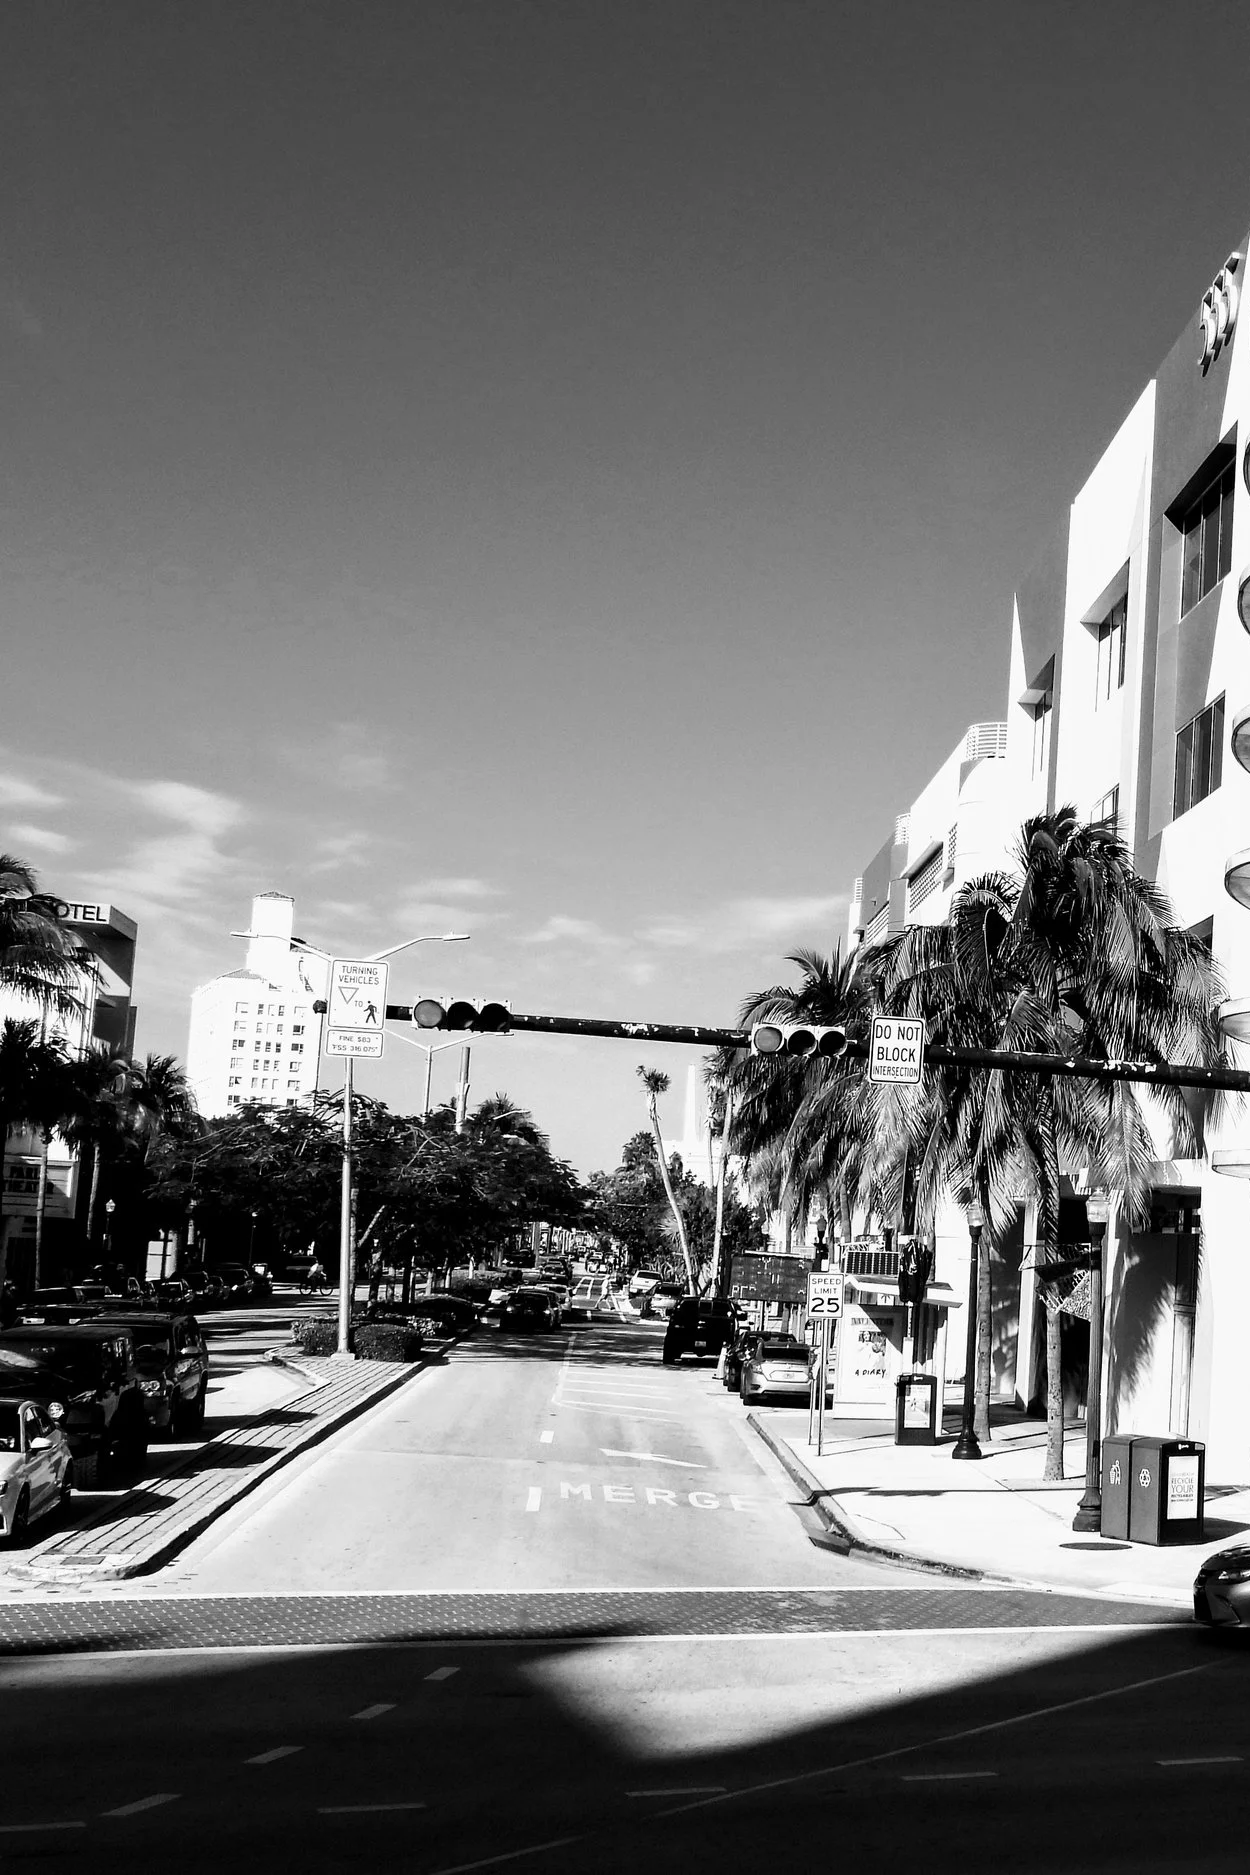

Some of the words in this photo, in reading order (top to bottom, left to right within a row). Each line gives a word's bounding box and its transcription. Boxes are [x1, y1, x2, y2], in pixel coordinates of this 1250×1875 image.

[56, 902, 107, 922] OTEL
[342, 965, 378, 976] TURNING
[339, 974, 380, 986] VEHICLES
[354, 1000, 364, 1008] TO
[875, 1024, 892, 1039] DO
[897, 1026, 921, 1041] NOT
[877, 1046, 916, 1063] BLOCK
[873, 1065, 919, 1077] INTERSECTION
[814, 1287, 837, 1295] LIMIT
[811, 1297, 840, 1313] 25
[862, 1369, 887, 1379] DIARY
[1171, 1484, 1194, 1493] YOUR
[560, 1481, 760, 1511] MERGE
